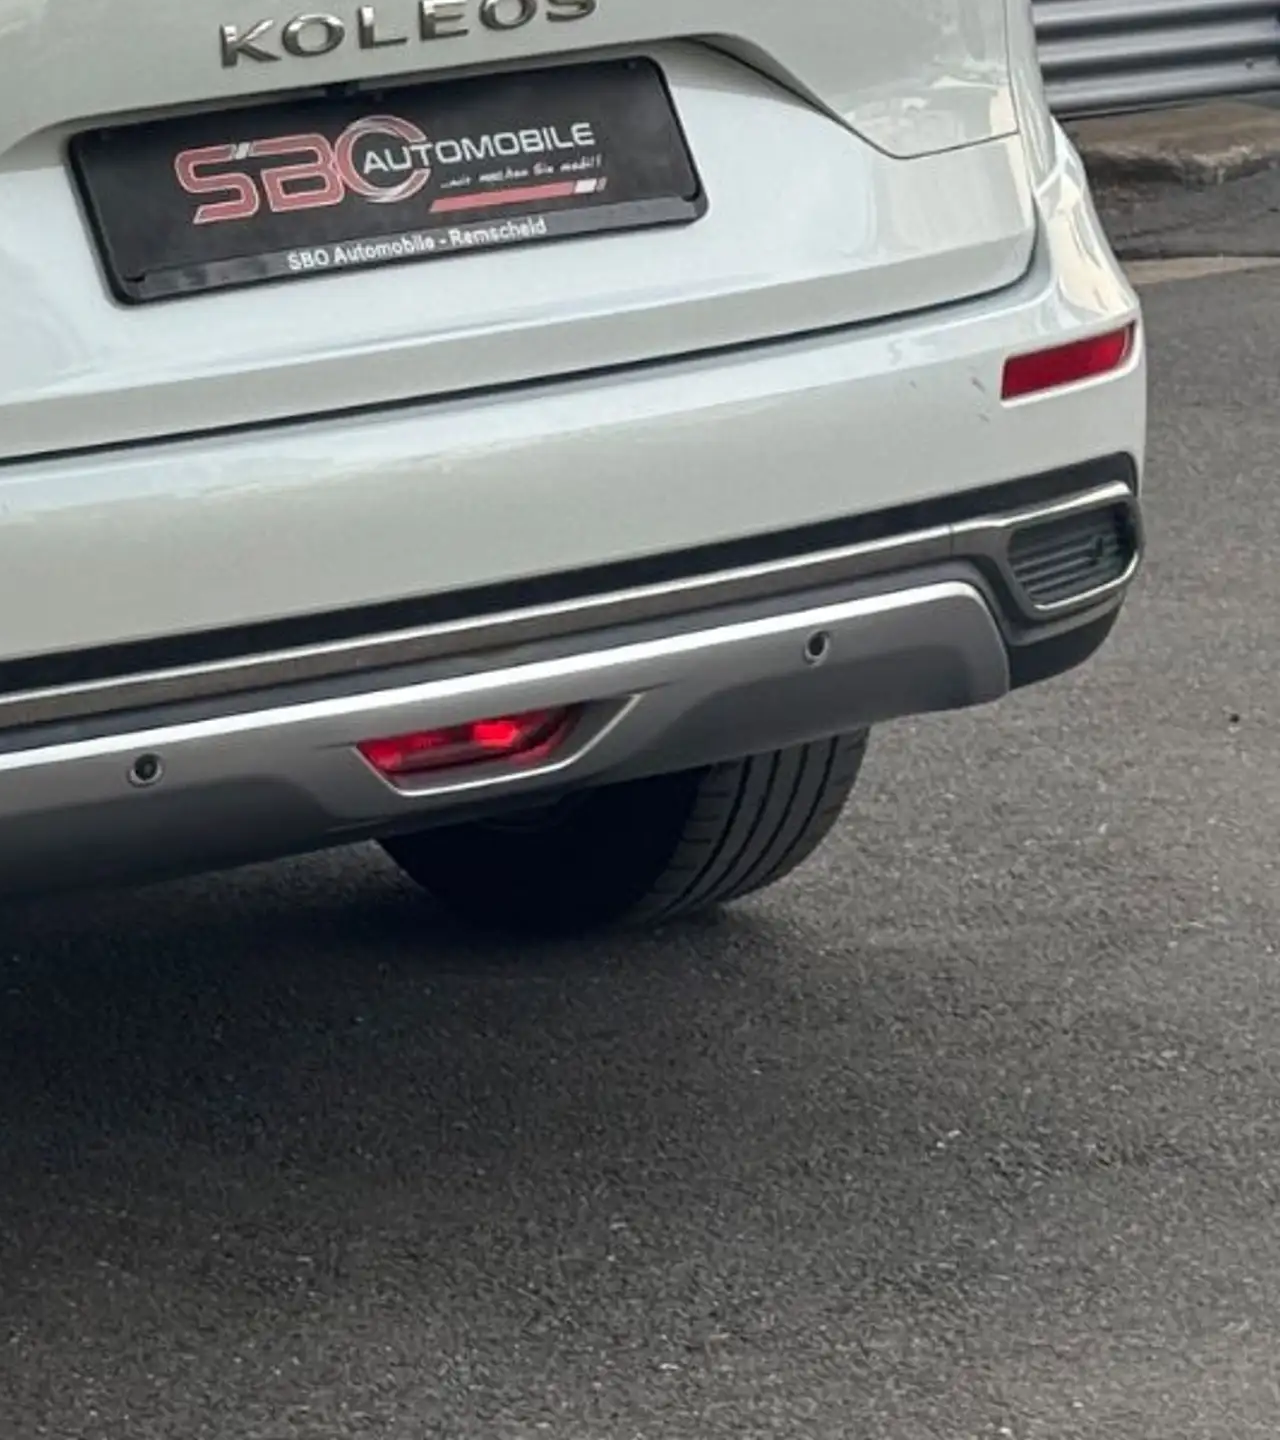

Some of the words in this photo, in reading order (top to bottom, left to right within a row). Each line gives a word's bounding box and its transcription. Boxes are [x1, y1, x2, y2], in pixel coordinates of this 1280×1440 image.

[362, 122, 596, 175] AUTOMOBILE
[286, 251, 330, 271] SBO
[333, 236, 435, 266] Automobile
[449, 217, 547, 247] Remscheid
